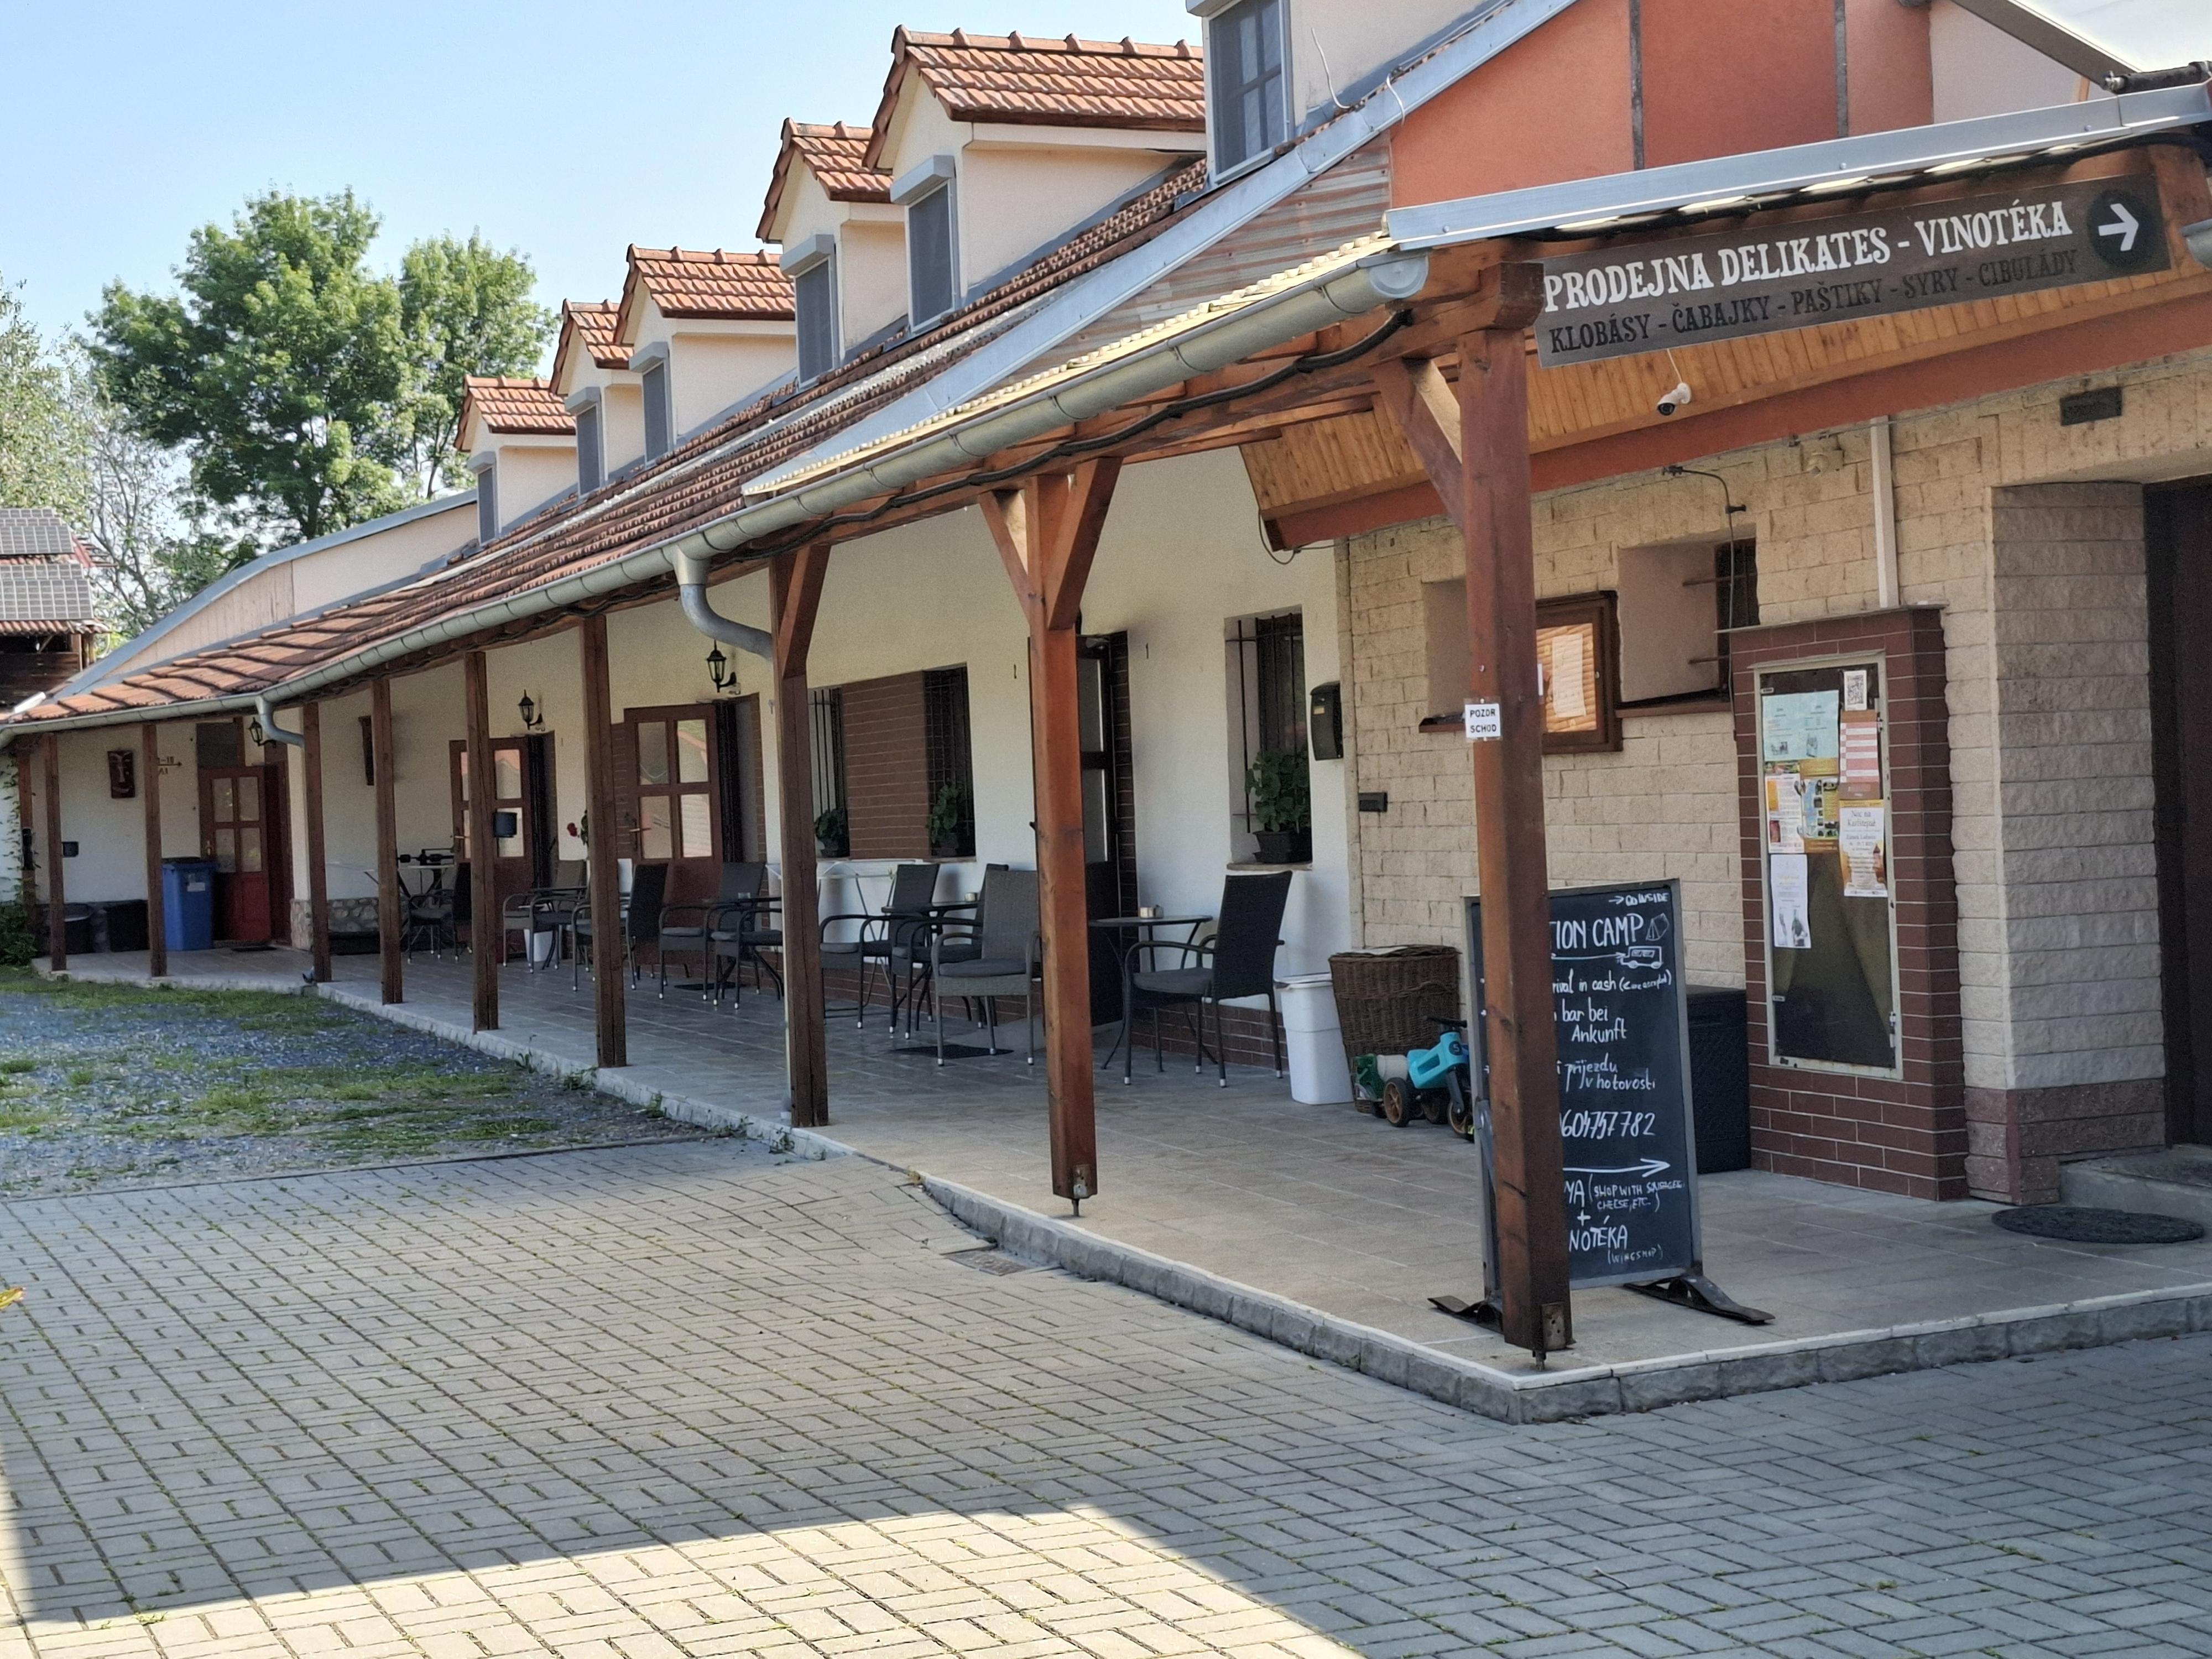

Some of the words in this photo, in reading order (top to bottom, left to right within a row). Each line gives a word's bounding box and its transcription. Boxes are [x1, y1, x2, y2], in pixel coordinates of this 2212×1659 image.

[1545, 253, 1714, 312] PRODEJNA
[1718, 227, 1891, 286] DELIKATES
[1914, 199, 2073, 257] VINOTÉKA
[1549, 313, 1650, 353] KLOBÁSY
[1672, 295, 1770, 333] ČABAJKY
[1791, 279, 1882, 315] PAŠTIKY
[1902, 268, 1958, 298] SYRY
[1978, 249, 2078, 286] CIBULÁDY
[1470, 708, 1496, 718] POZOR
[1470, 724, 1496, 733] SCHOD
[1593, 913, 1644, 947] CAMP
[1552, 968, 1574, 994] rival
[1579, 978, 1588, 992] in
[1592, 969, 1616, 992] cash
[1562, 998, 1585, 1021] bar
[1588, 997, 1608, 1021] bei
[1571, 1017, 1627, 1044] Ankunft
[1597, 1067, 1655, 1091] hotovosti
[1564, 1179, 1585, 1207] NA
[1619, 1184, 1643, 1196] WITH
[1569, 1215, 1628, 1252] NOTÉKA
